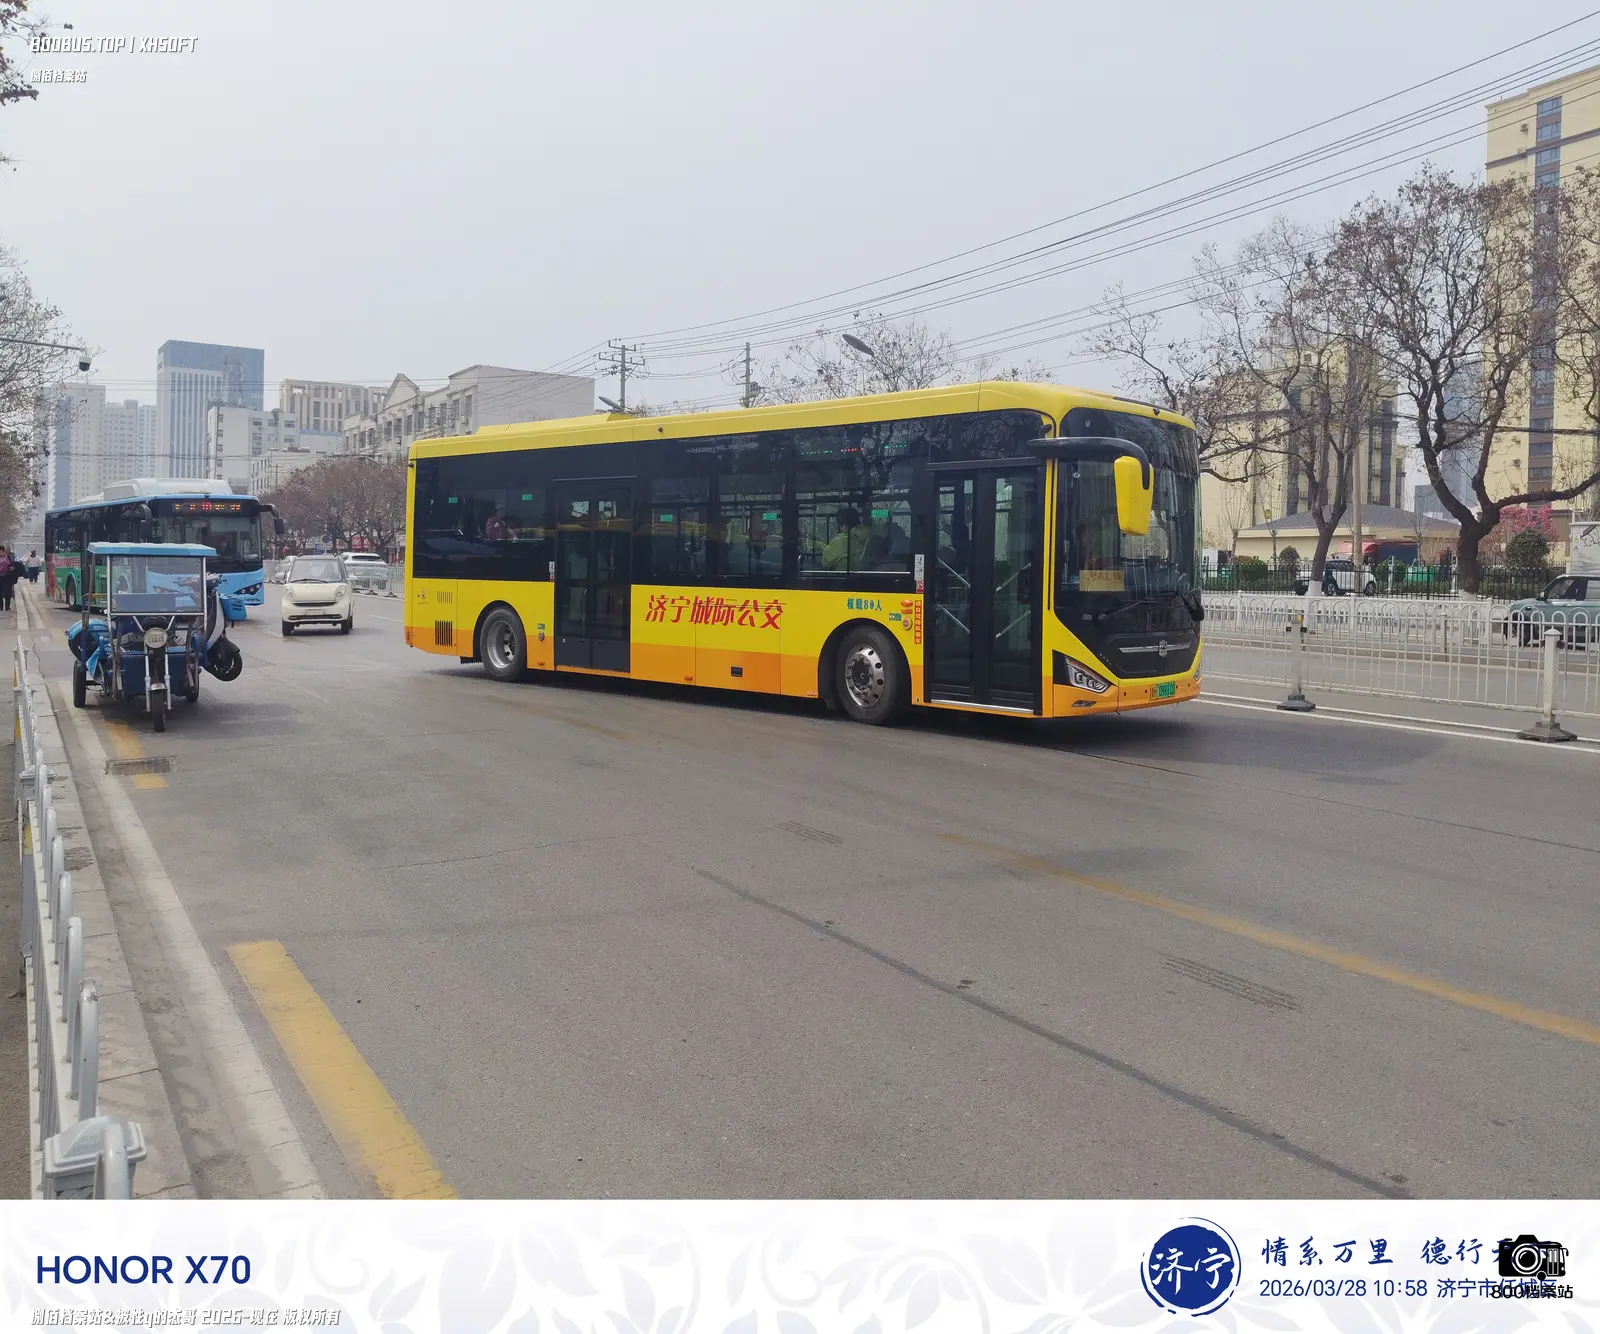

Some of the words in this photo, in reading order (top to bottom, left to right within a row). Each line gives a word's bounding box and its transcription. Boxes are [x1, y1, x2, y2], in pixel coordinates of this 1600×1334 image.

[645, 594, 787, 630] 济宁城际公交
